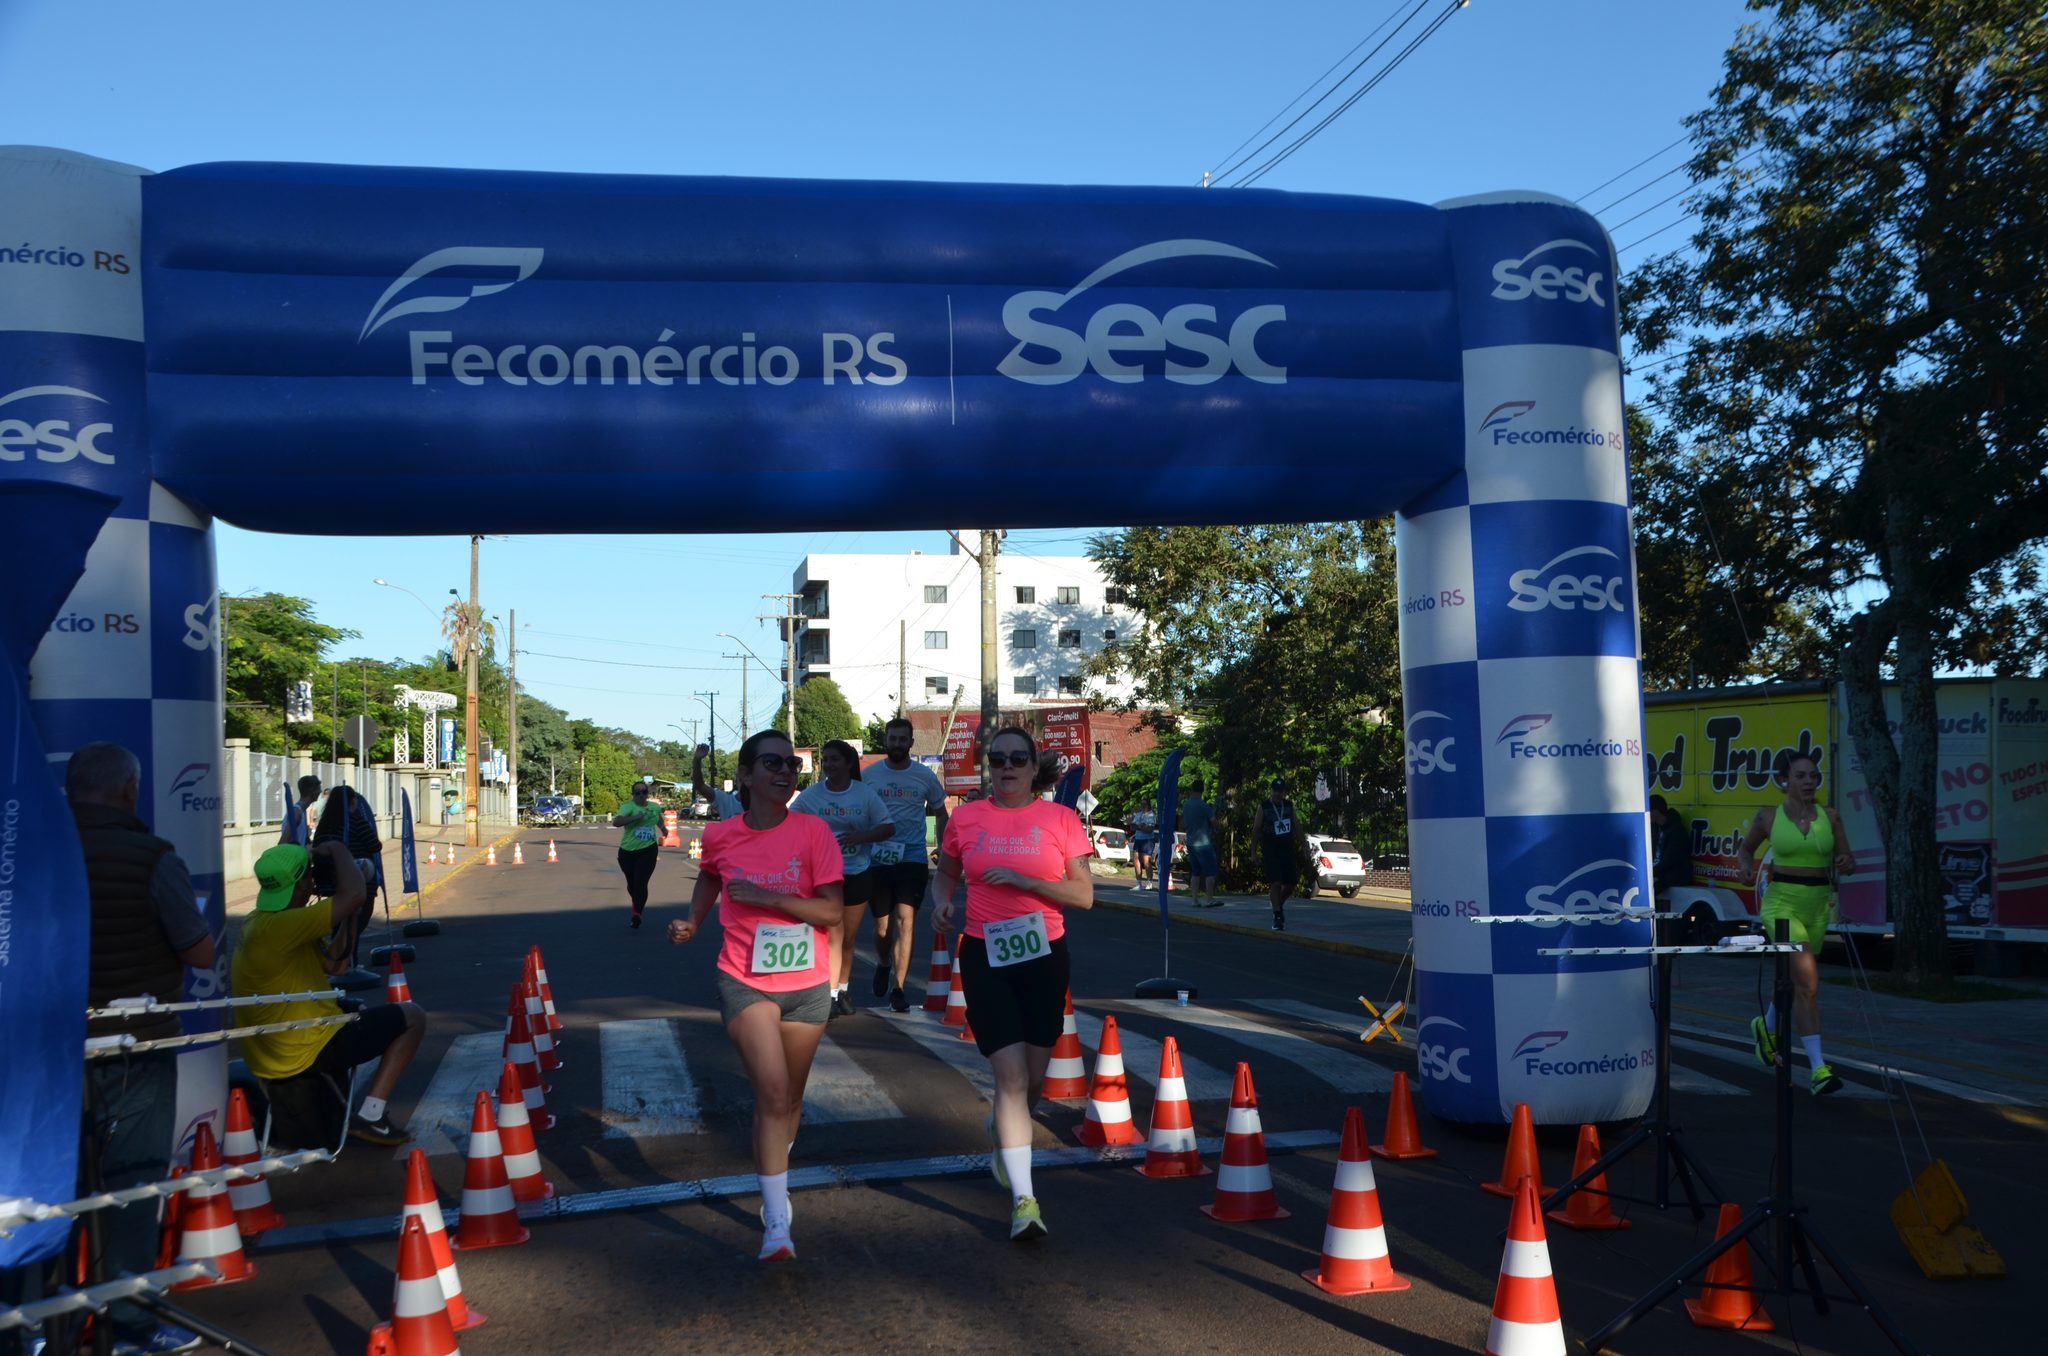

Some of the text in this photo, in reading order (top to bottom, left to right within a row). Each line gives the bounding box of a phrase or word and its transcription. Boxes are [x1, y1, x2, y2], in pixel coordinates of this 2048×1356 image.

[94, 250, 131, 275] RS
[1490, 258, 1606, 308] Sesc
[995, 289, 1289, 386] Sesc
[408, 328, 908, 386] Fecomércio RS
[1493, 426, 1622, 450] Fecomércio RS
[1440, 588, 1465, 608] RS
[1506, 568, 1625, 612] Sesc
[104, 612, 140, 634] RS
[1510, 738, 1640, 759] Fecomércio RS
[1, 798, 20, 884] Comércio
[988, 837, 1024, 846] MAIS QUE
[988, 846, 1041, 856] VENCEDORAS
[874, 848, 900, 864] 425
[746, 873, 784, 884] MAIS QUE
[1455, 900, 1481, 918] RS
[1524, 884, 1642, 929] Sesc
[761, 941, 809, 969] 302
[993, 929, 1042, 962] 390
[1526, 1048, 1655, 1076] Fecomércio RS
